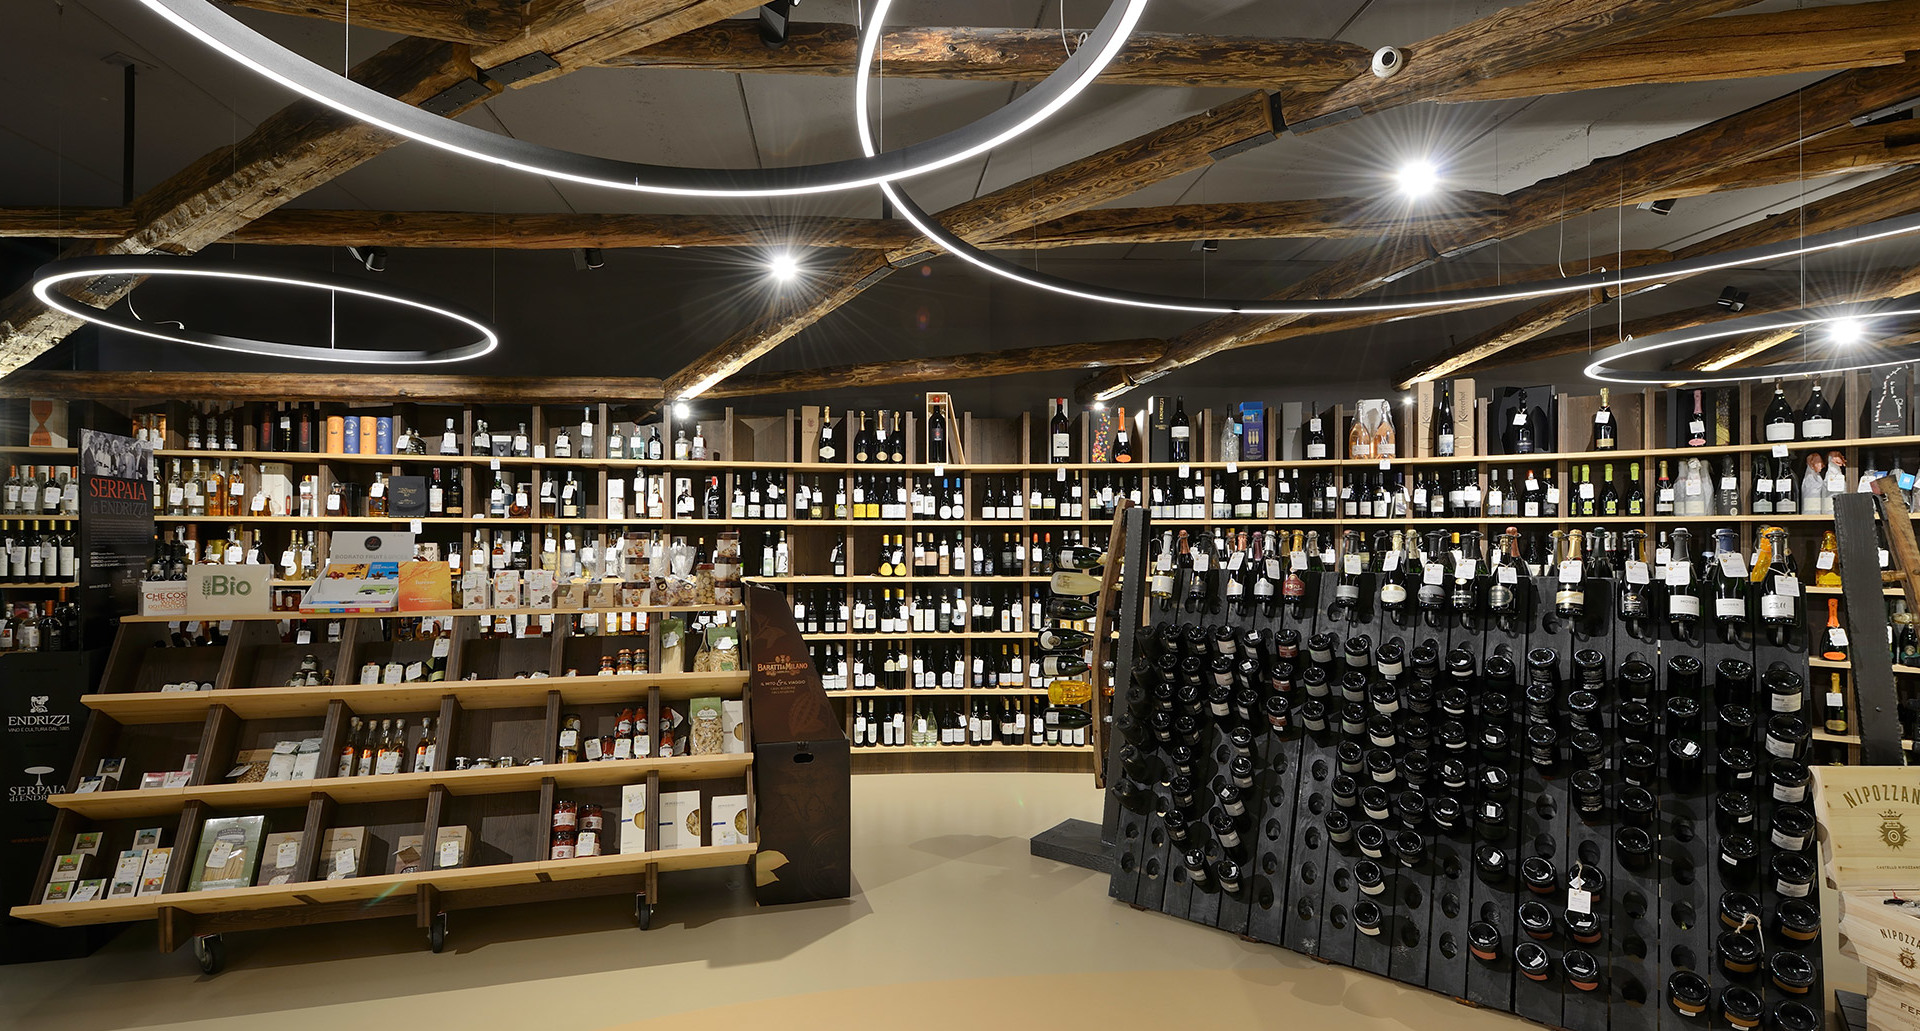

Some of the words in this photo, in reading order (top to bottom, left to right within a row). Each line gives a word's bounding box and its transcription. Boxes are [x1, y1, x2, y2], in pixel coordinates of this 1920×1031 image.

[90, 477, 147, 501] SERPAIA
[90, 501, 98, 514] di
[100, 500, 148, 518] ENDRIZZI
[211, 575, 252, 597] Bio
[145, 592, 165, 600] CHE
[8, 714, 70, 727] ENDRIZZI
[9, 784, 66, 796] SERPAIA
[9, 794, 18, 802] di
[19, 794, 48, 802] ENDR
